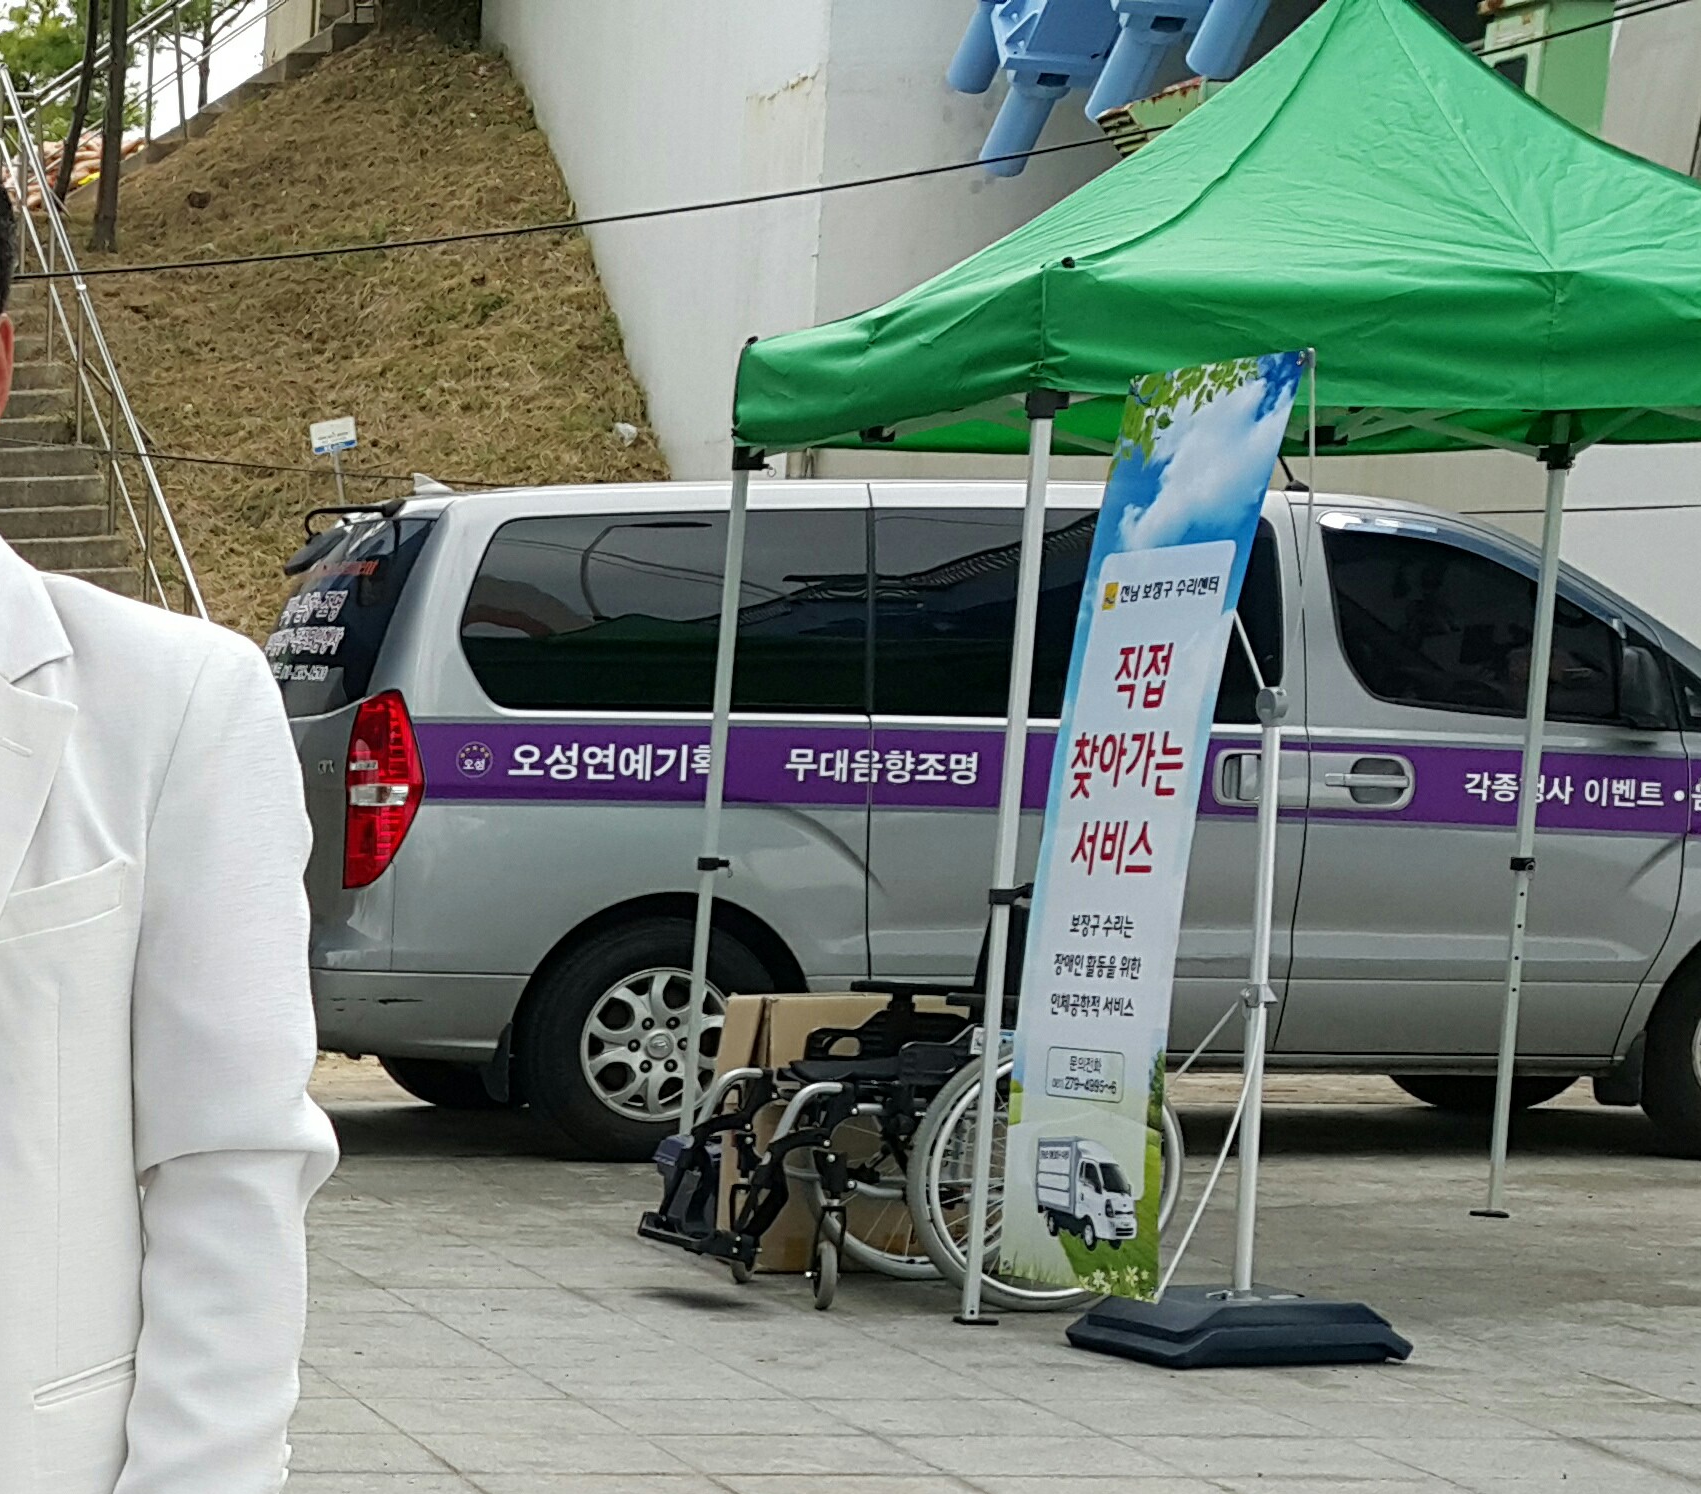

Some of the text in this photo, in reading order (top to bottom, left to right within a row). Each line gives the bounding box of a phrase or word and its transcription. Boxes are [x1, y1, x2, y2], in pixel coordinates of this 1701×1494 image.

[1114, 642, 1175, 709] 직접
[784, 748, 978, 785] 무대음향조명
[1584, 777, 1665, 807] 이벤트
[1070, 730, 1184, 800] 찾아가는
[1070, 820, 1153, 876] 서비스
[1069, 914, 1135, 939] 보장구 수리는
[1054, 953, 1142, 980] 장애인 활동을 위한
[1103, 996, 1135, 1017] 서비스
